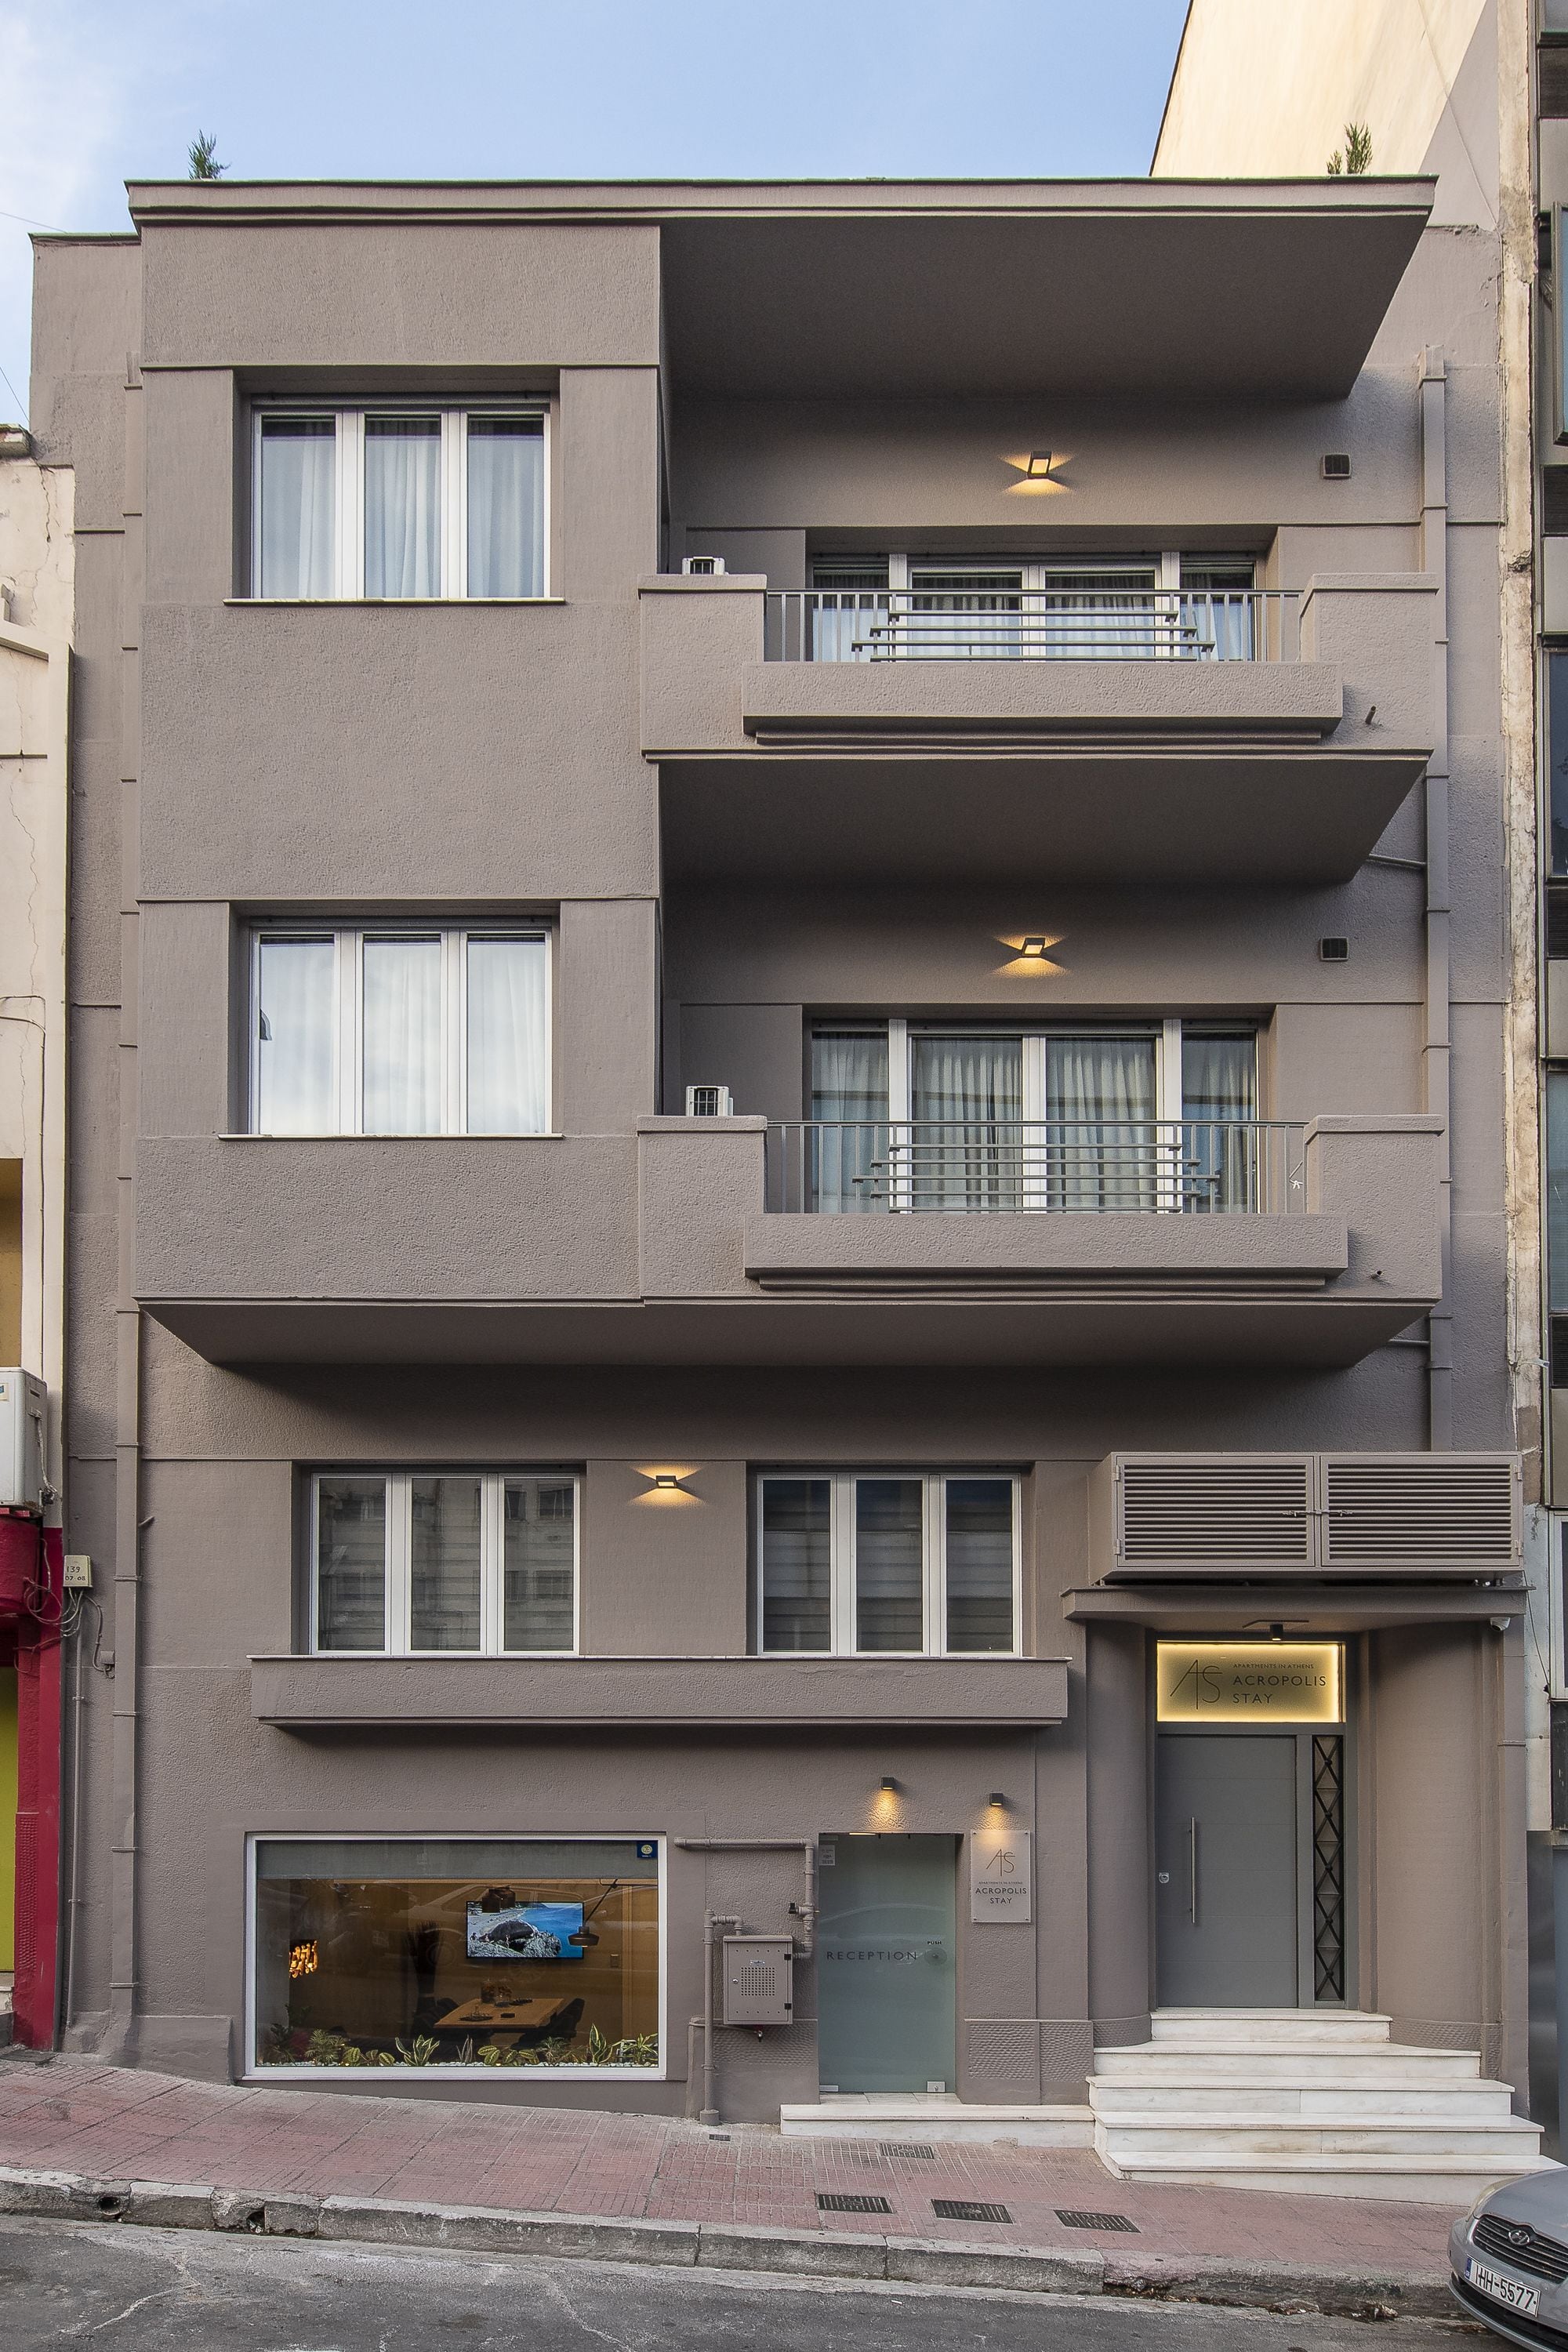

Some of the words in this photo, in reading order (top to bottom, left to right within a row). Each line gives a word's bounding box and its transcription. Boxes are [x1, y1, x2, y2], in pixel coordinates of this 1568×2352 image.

[1232, 1675, 1327, 1686] ACROPOLIS
[1232, 1693, 1273, 1704] STAY
[826, 1951, 917, 1960] RECEPTION
